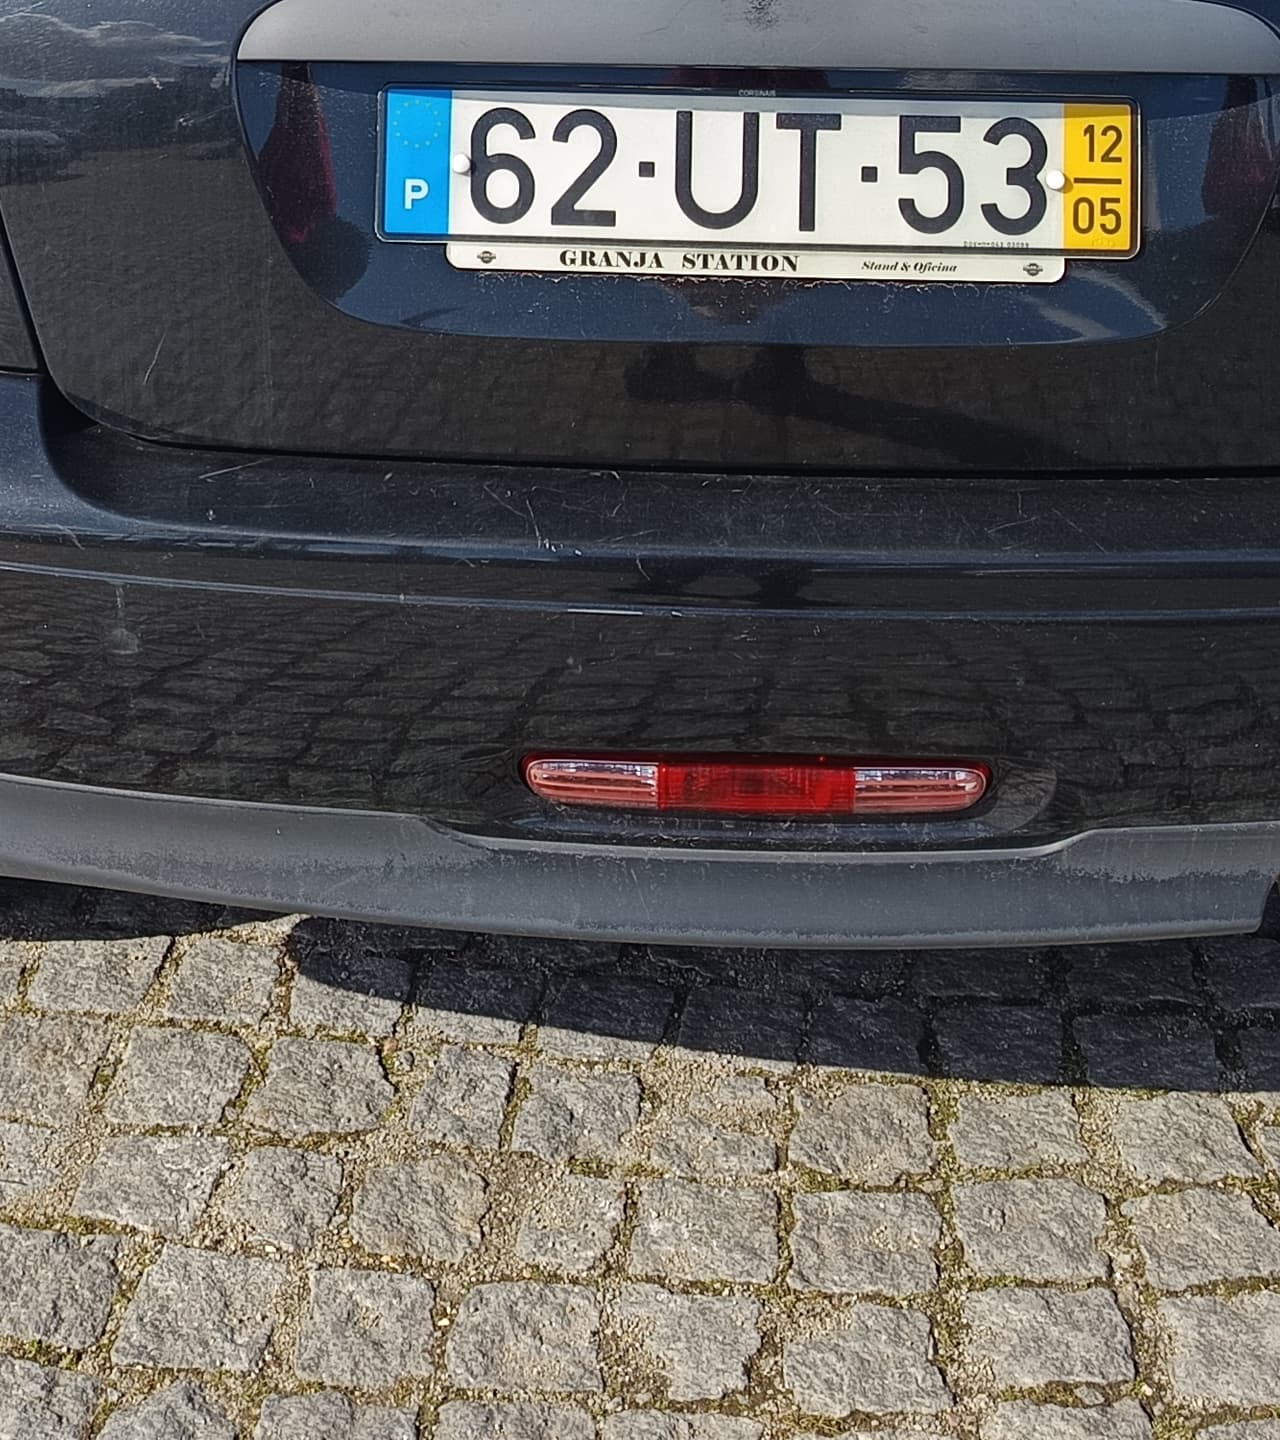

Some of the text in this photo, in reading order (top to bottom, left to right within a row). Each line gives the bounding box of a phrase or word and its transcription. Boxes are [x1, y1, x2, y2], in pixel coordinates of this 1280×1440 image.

[1083, 124, 1123, 163] 12
[403, 177, 430, 210] P
[1072, 196, 1123, 235] 05
[560, 248, 800, 272] GRANJA STATION
[861, 260, 898, 272] Stand
[913, 261, 958, 274] Oficina
